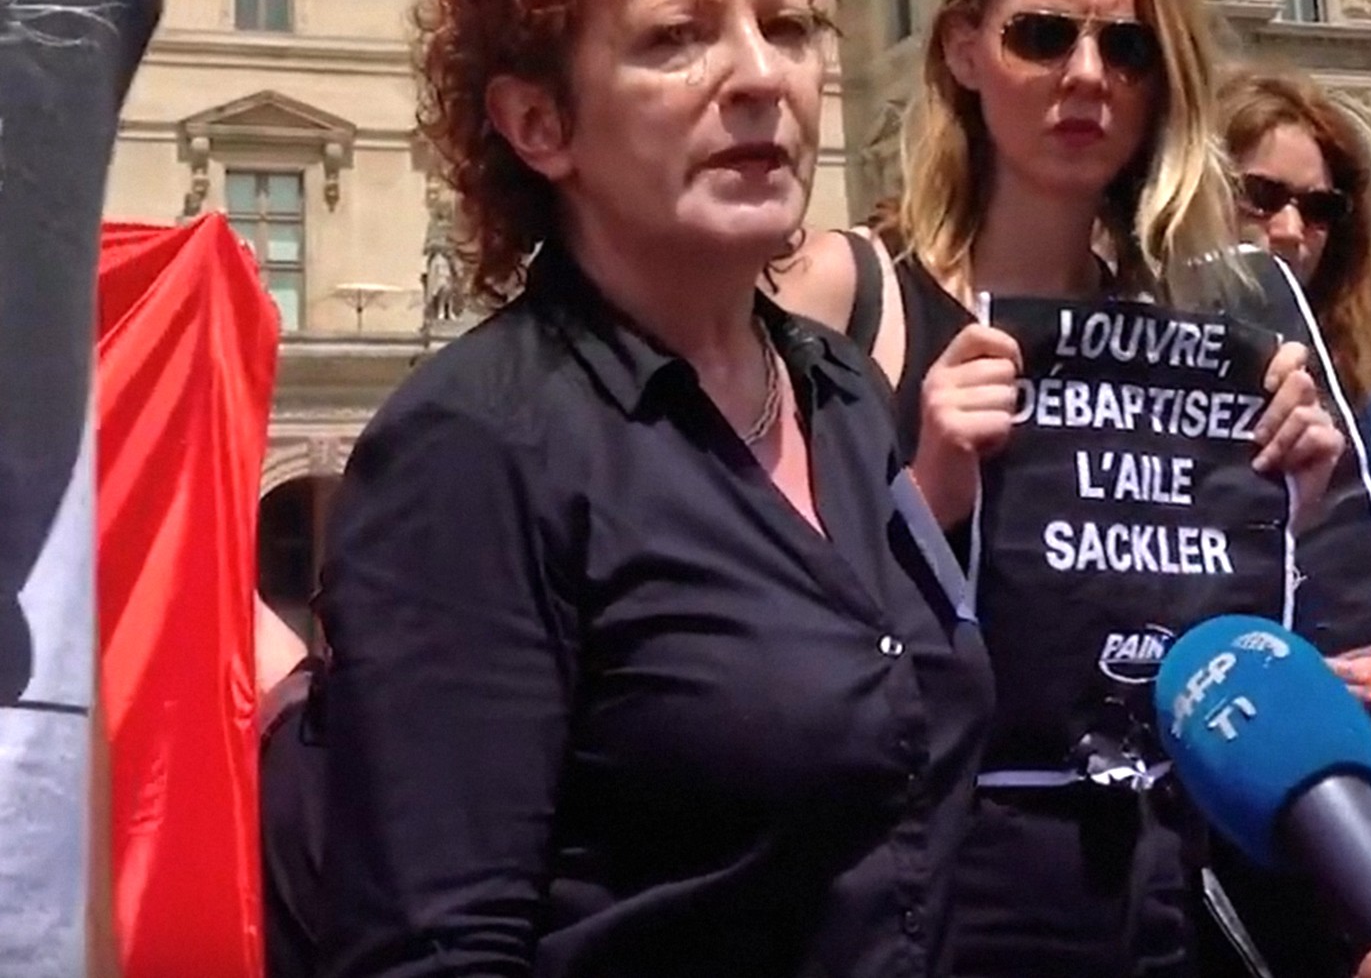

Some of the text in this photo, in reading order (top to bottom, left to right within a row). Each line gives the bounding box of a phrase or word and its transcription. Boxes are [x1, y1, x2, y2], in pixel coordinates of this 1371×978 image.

[1056, 310, 1231, 378] LOUVRE,
[1076, 451, 1194, 505] L'AILE
[1045, 521, 1233, 574] SACKLER
[1101, 633, 1170, 660] PAIN
